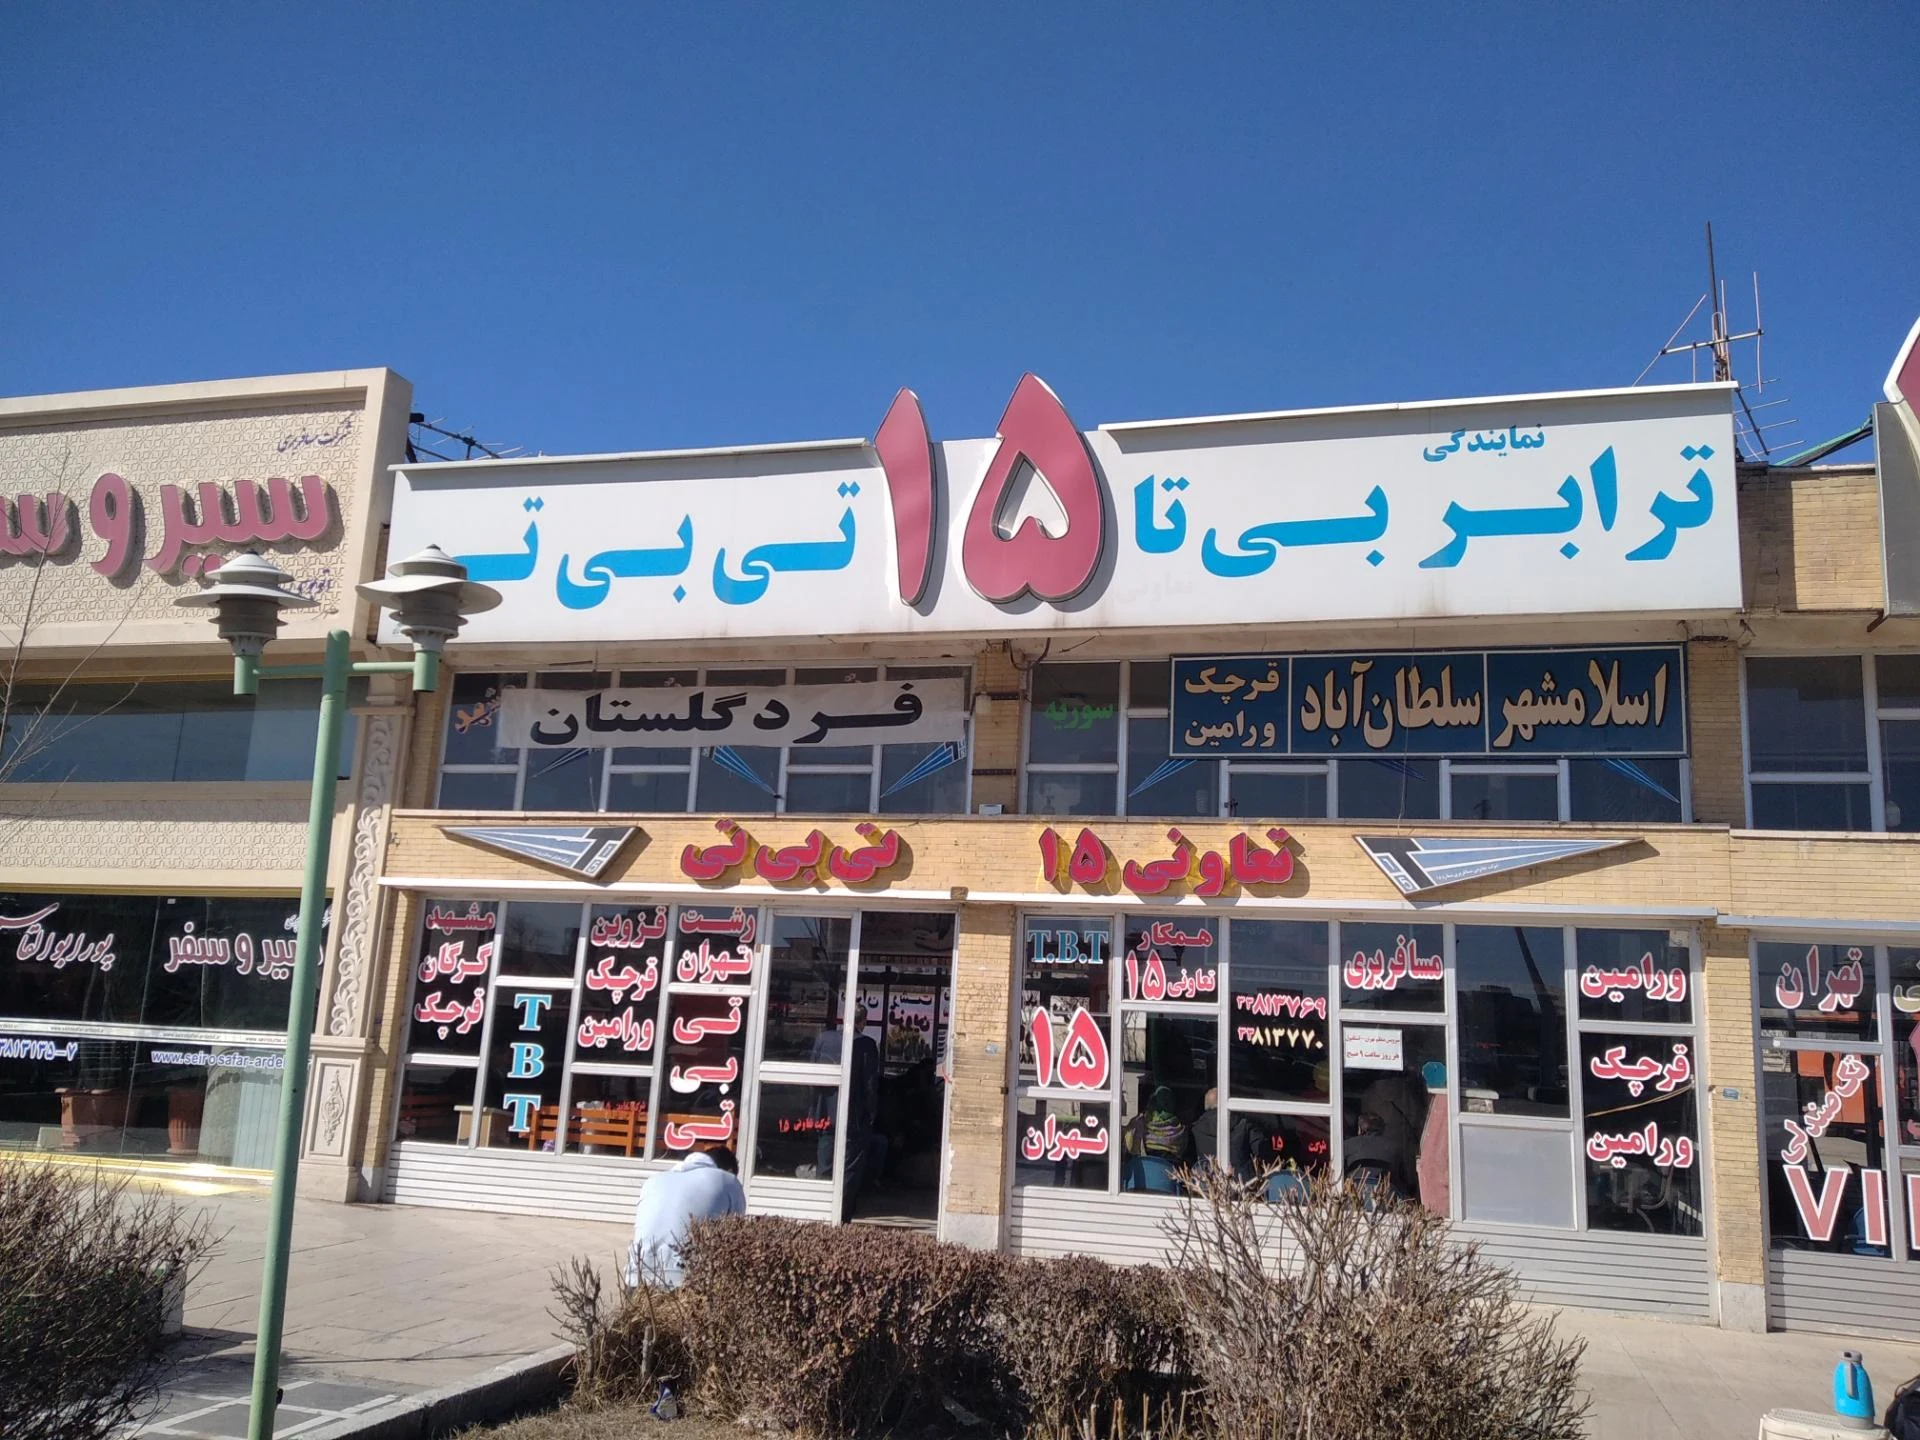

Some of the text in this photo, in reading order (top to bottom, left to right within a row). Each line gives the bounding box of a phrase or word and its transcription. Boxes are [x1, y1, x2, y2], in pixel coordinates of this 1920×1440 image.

[1423, 423, 1547, 463] نمایندگی
[452, 372, 1715, 610] ترابر بی تا ۱۵ تی بی ت
[89, 472, 136, 579] و
[1183, 661, 1281, 706] قرچک
[1493, 658, 1669, 749] اسلامشهر
[530, 691, 749, 746] گلستان
[1183, 709, 1278, 748] ورامین
[680, 816, 901, 885] تی بی تی
[1038, 825, 1295, 897] تعاونی ۱۵
[426, 902, 496, 936] مشهد
[591, 906, 668, 949] قزوین
[678, 905, 757, 944] رشت
[1136, 921, 1213, 951] همکار
[163, 921, 231, 973] سفر
[234, 933, 254, 975] و
[418, 940, 494, 984] گرگان
[676, 939, 754, 984] تهران
[1027, 929, 1109, 965] T.B.T
[1343, 934, 1444, 990] مسافربری
[586, 957, 658, 1005] قرچک
[1125, 949, 1217, 1000] تعاونی ۱۵
[1580, 952, 1686, 1002] ورامین
[1776, 945, 1864, 1013] تهران
[414, 987, 485, 1041] قرچک
[577, 1006, 655, 1052] ورامین
[673, 996, 743, 1045] تی
[1030, 1006, 1109, 1090] ۱۵
[1590, 1044, 1691, 1097] قرچک
[669, 1056, 739, 1096] بی
[664, 1099, 735, 1151] تی
[1021, 1113, 1108, 1161] تهران
[1586, 1121, 1694, 1168] ورامین
[1783, 1164, 1920, 1251] VI
